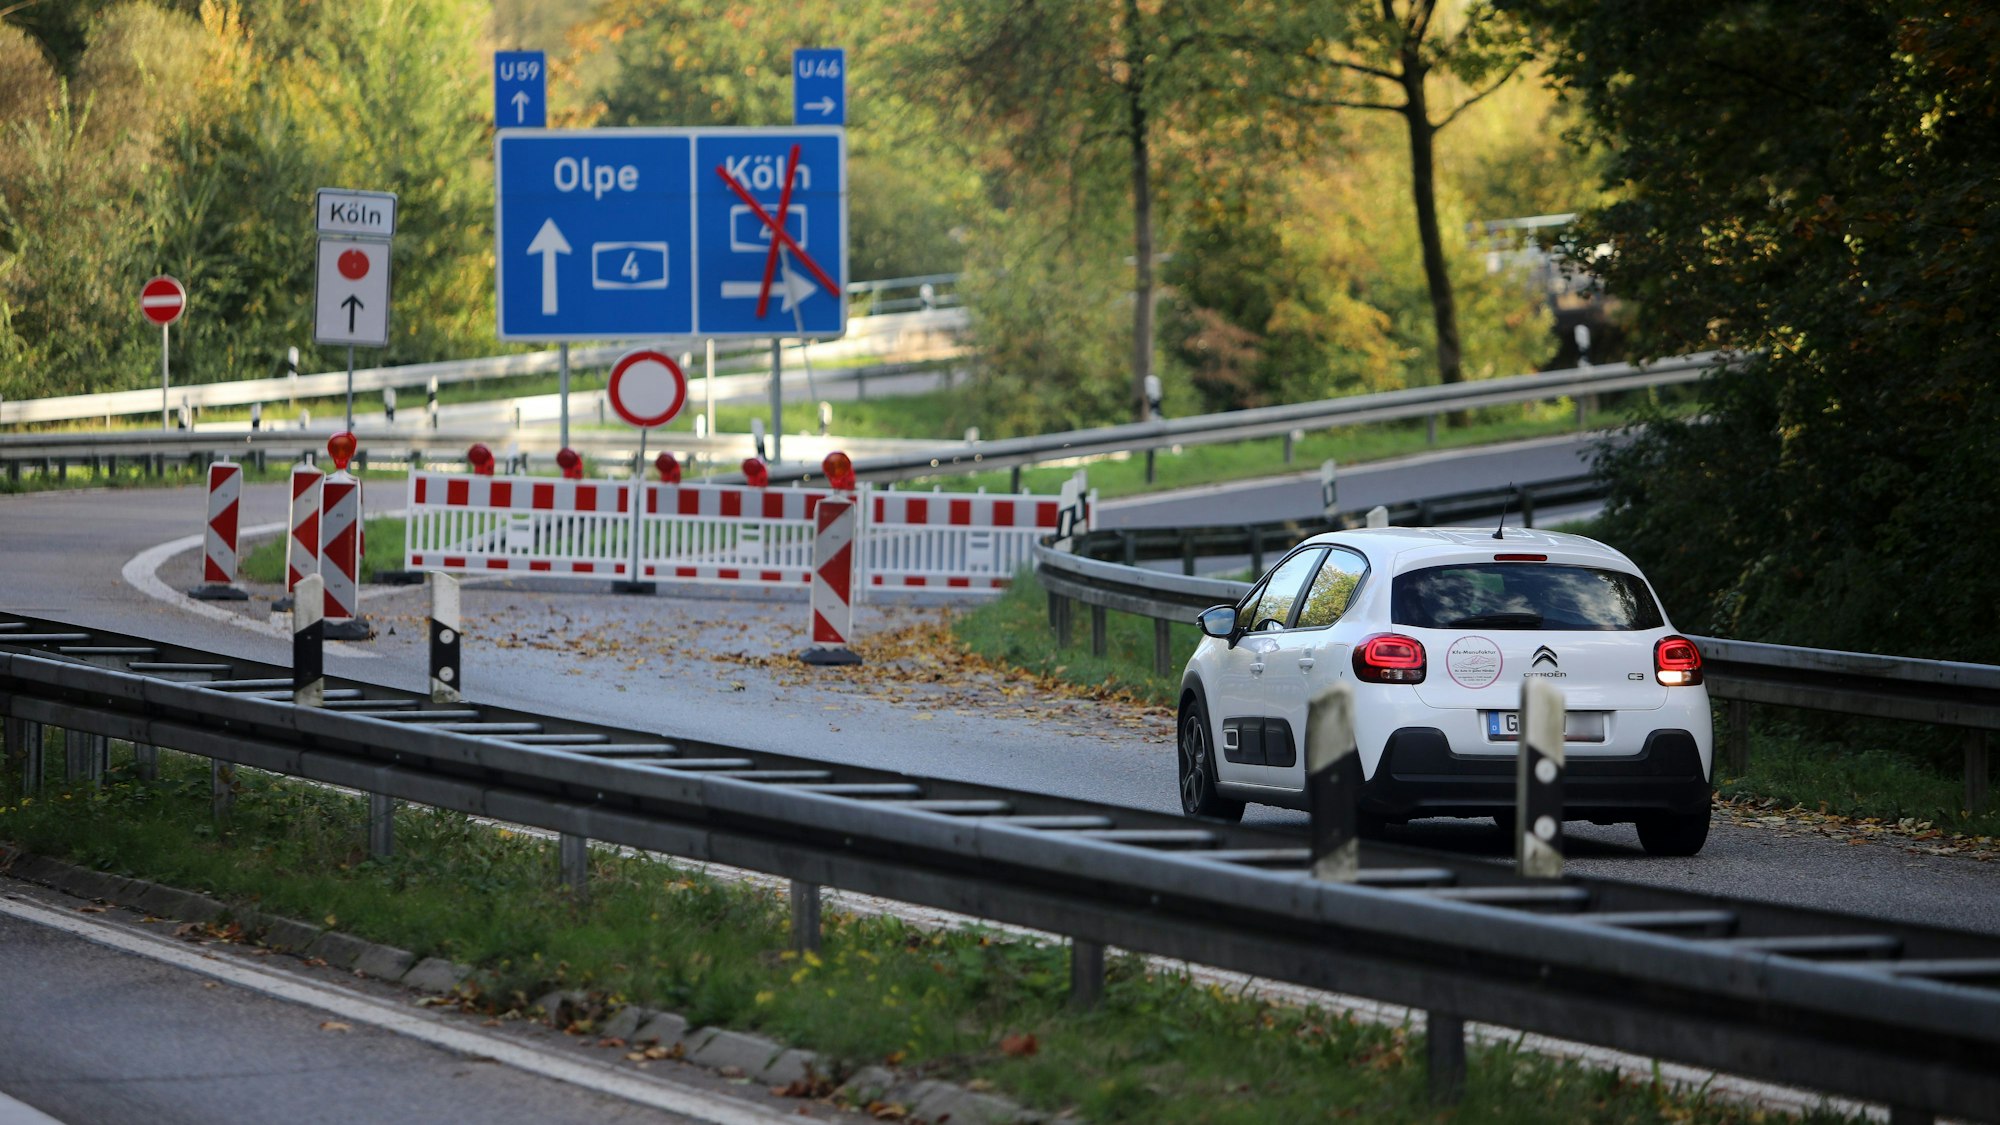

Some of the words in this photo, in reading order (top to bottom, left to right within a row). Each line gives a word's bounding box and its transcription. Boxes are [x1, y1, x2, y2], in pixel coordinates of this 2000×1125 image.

[554, 156, 639, 201] Olpe
[726, 155, 810, 190] Köln
[331, 202, 381, 225] Köln
[621, 250, 640, 280] 4
[1628, 672, 1644, 681] C3
